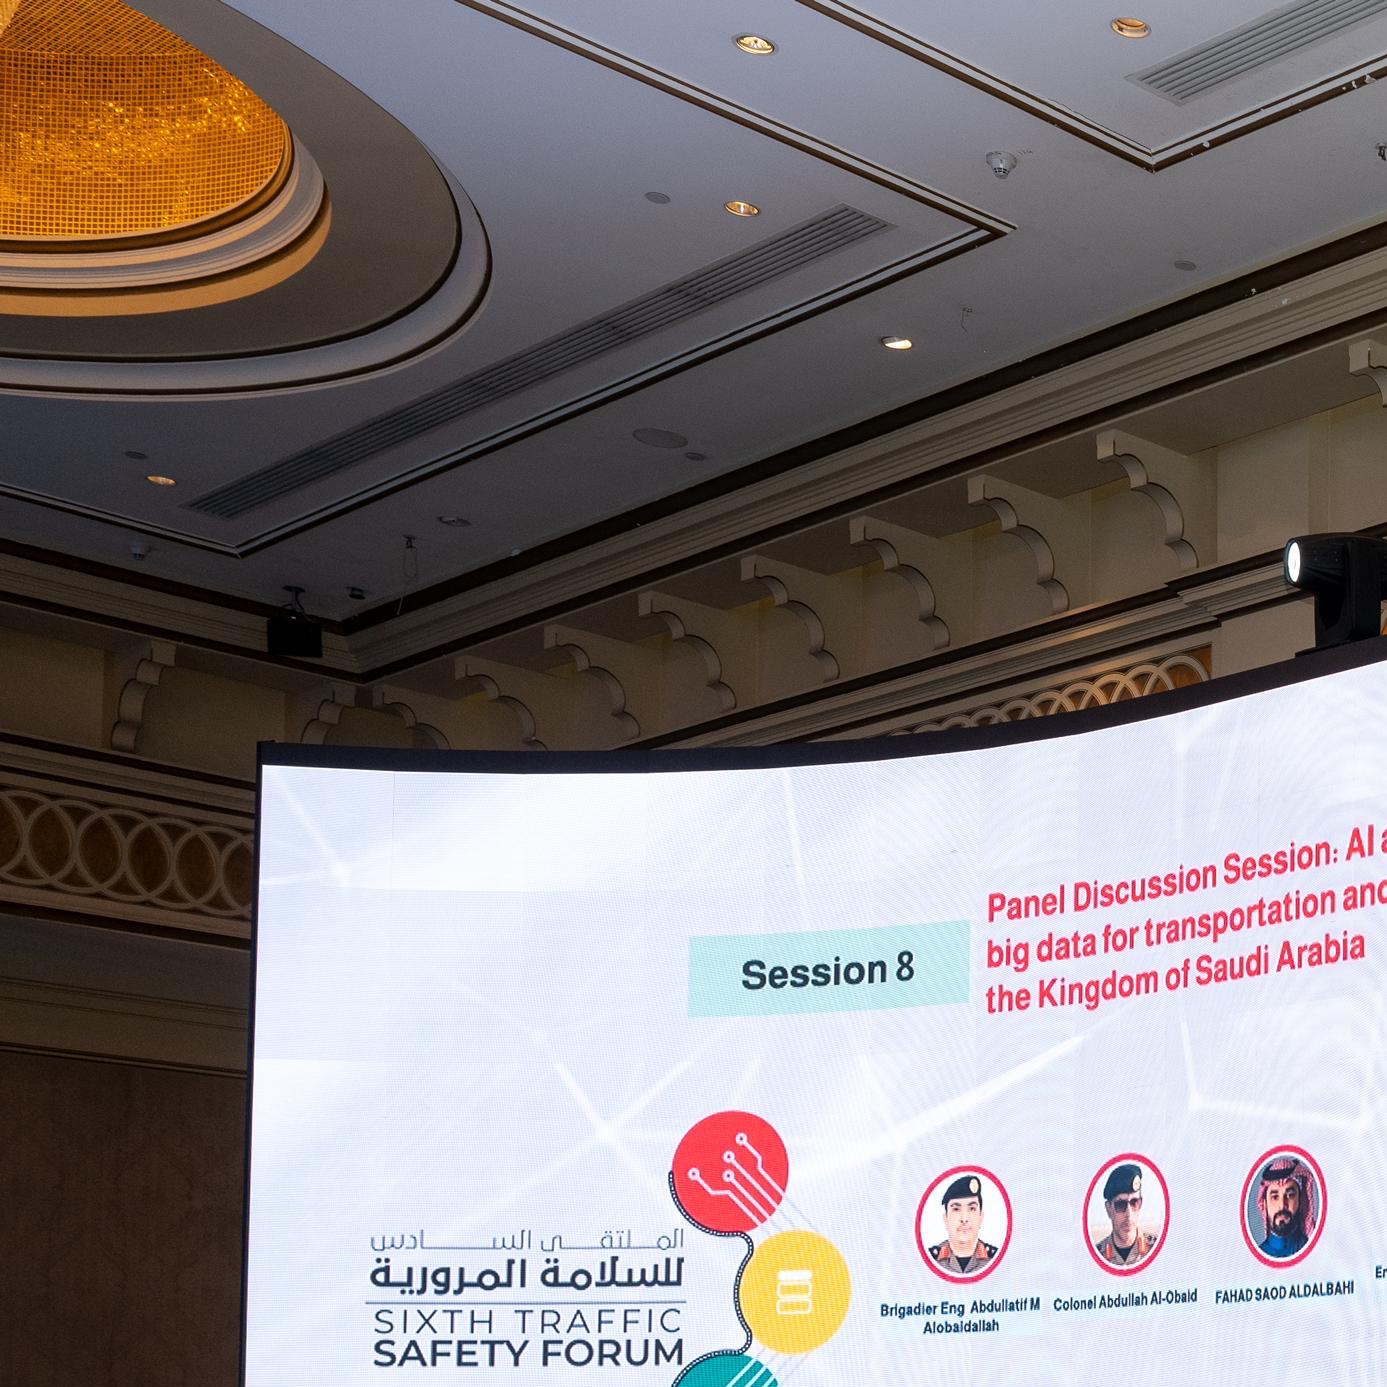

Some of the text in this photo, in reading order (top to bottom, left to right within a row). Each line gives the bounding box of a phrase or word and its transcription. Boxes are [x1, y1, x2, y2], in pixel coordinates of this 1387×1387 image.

[988, 884, 1065, 922] Panel
[1074, 864, 1216, 912] Discussion
[1223, 841, 1339, 884] Session:
[1346, 824, 1374, 861] AI
[987, 938, 1029, 973] big
[1036, 930, 1096, 962] data
[1103, 924, 1139, 953] for
[1144, 889, 1336, 947] transportation
[742, 950, 915, 990] Session 8
[985, 930, 1365, 1014] the Kingdom of Saudi Arabia
[369, 1256, 685, 1296] للسلامة المرورية
[1215, 1287, 1253, 1305] FAHAD
[1289, 1281, 1355, 1300] ALDALBAHI
[880, 1297, 1041, 1319] Brigadier Eng Abdullatif M
[1053, 1296, 1097, 1312] Colonel
[1099, 1293, 1148, 1309] Abdullah
[373, 1308, 682, 1335] SIXTH TRAFFIC
[372, 1338, 685, 1368] SAFETY FORUM
